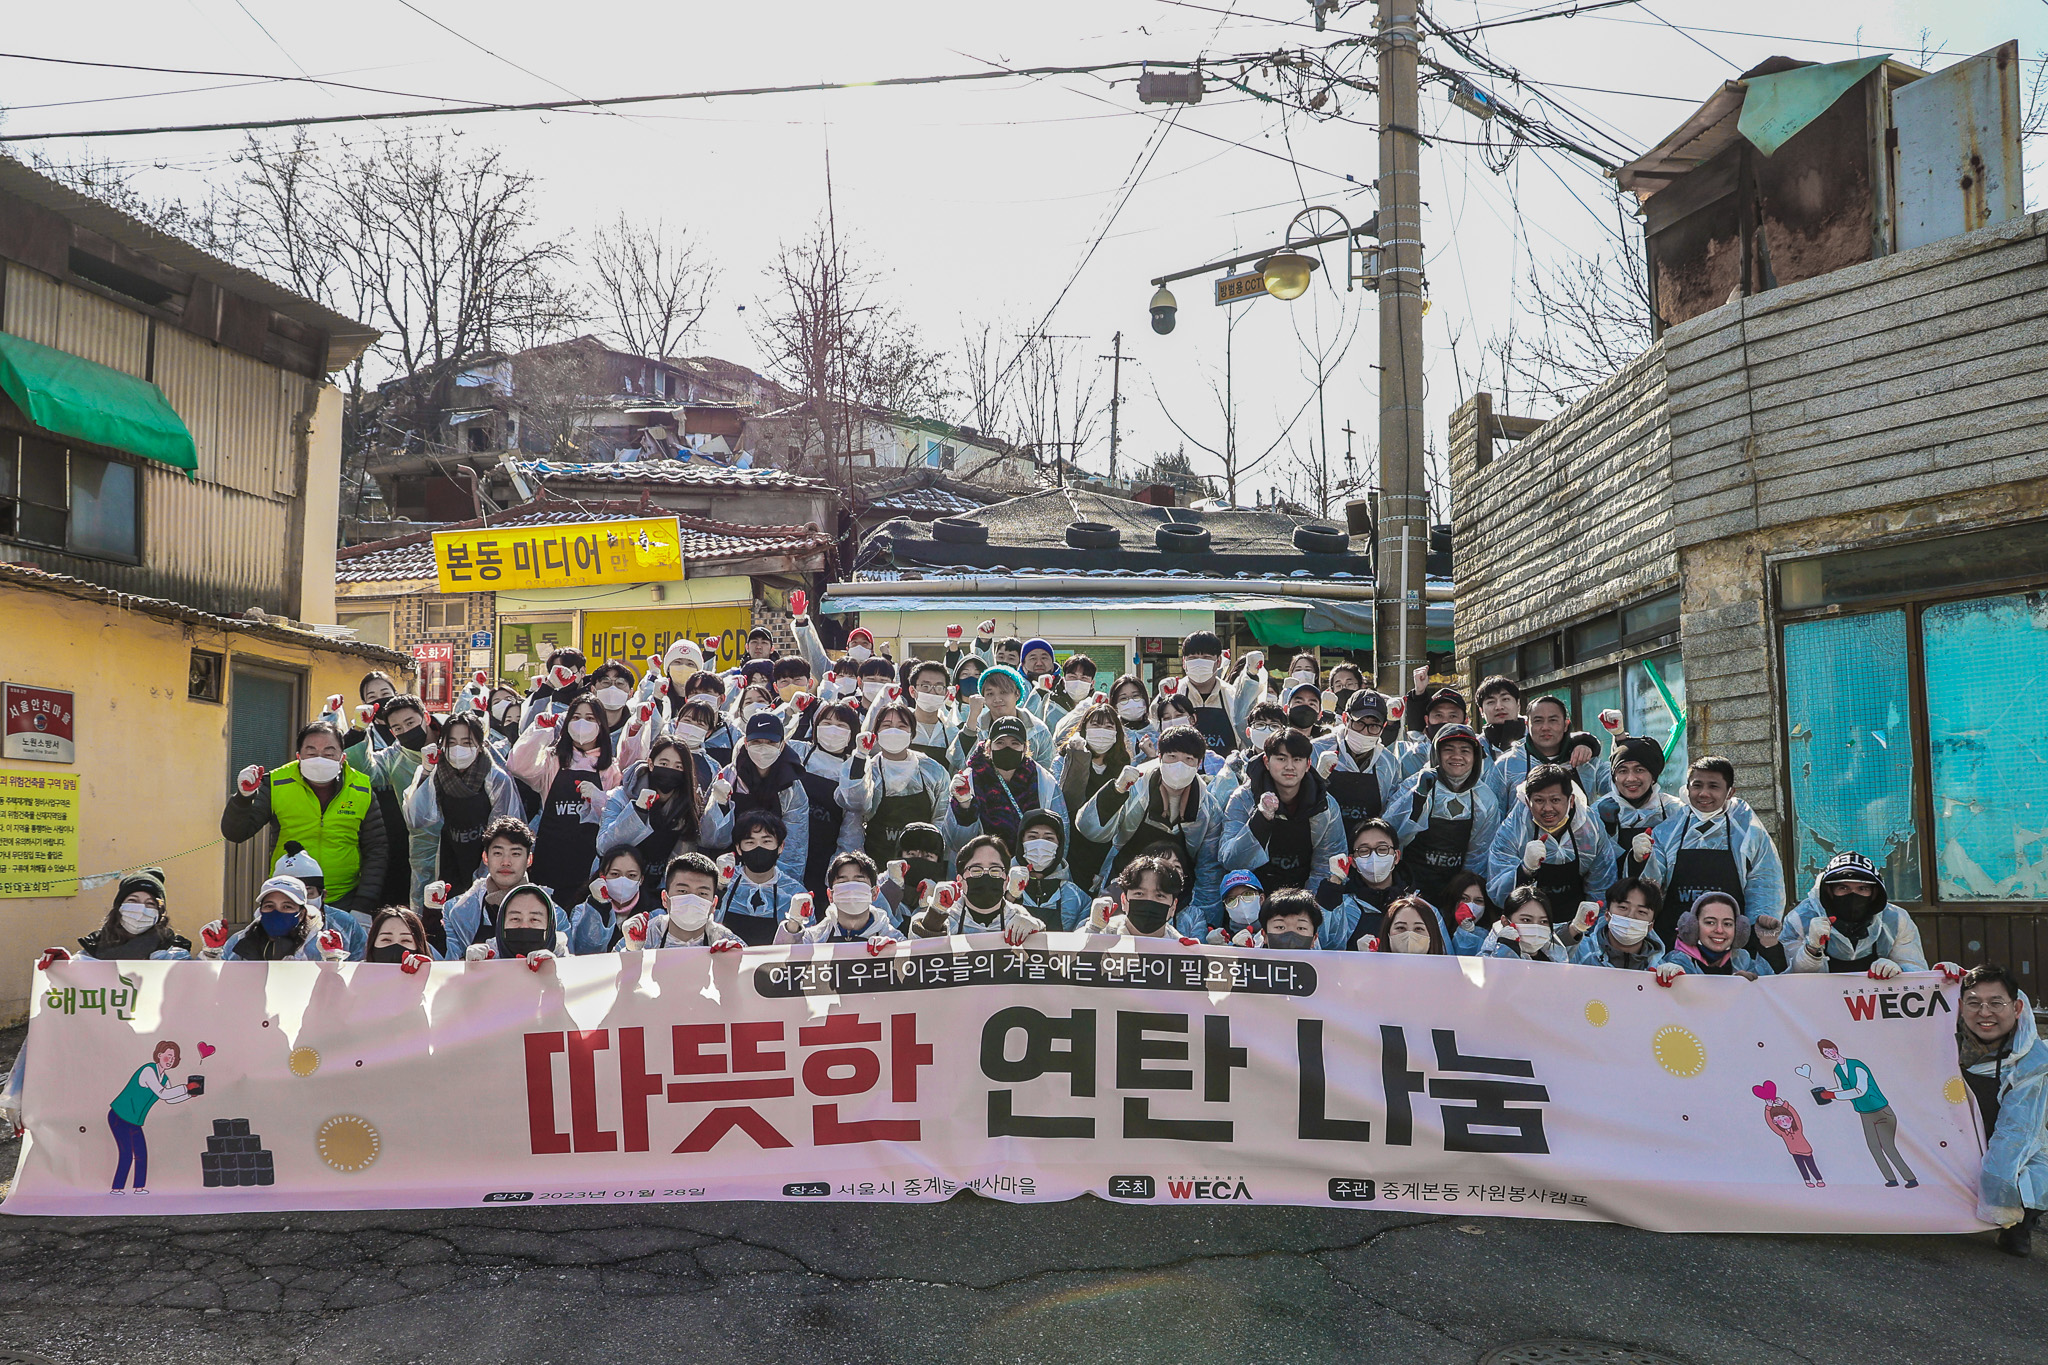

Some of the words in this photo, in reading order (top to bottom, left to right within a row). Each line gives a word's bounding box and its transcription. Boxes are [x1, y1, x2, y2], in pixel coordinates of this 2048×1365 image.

[1220, 282, 1243, 298] 방범용
[446, 541, 503, 582] 본동
[513, 534, 602, 579] 미디어
[476, 639, 486, 647] 32
[591, 631, 648, 664] 비디오
[416, 647, 450, 660] 소화기
[9, 698, 71, 726] 서울안전마을
[22, 738, 59, 749] 노원소방서
[9, 775, 45, 789] 위험건축물
[47, 778, 61, 790] 구역
[63, 779, 76, 791] 알림
[6, 824, 12, 833] 이
[13, 824, 30, 833] 지역을
[14, 838, 42, 847] 유의하시기
[12, 851, 34, 860] 무단침입
[35, 851, 46, 860] 또는
[1425, 852, 1462, 868] WECA
[54, 864, 77, 873] 있습니다.
[769, 961, 840, 991] 여전히
[847, 960, 894, 987] 우리
[901, 953, 994, 984] 이웃들의
[1003, 953, 1096, 982] 겨울에는
[1102, 955, 1172, 984] 연탄이
[1179, 959, 1303, 990] 필요합니다.
[45, 981, 138, 1021] 해피빈
[1844, 990, 1951, 1021] WECA
[523, 1012, 934, 1155] 따뜻한
[979, 1005, 1248, 1143] 연탄
[1297, 1018, 1550, 1155] 나눔
[492, 1192, 527, 1201] 일자
[538, 1190, 606, 1200] 2023년
[613, 1189, 655, 1198] 01월
[663, 1187, 706, 1197] 28일
[790, 1184, 824, 1195] 장소
[837, 1180, 895, 1196] 서울시
[903, 1176, 957, 1196] 중계동
[1115, 1179, 1148, 1196] 주최
[1168, 1181, 1253, 1200] WECA
[1335, 1182, 1369, 1198] 주관
[1381, 1181, 1460, 1202] 중계본동
[1466, 1183, 1588, 1207] 자원봉사캠프
